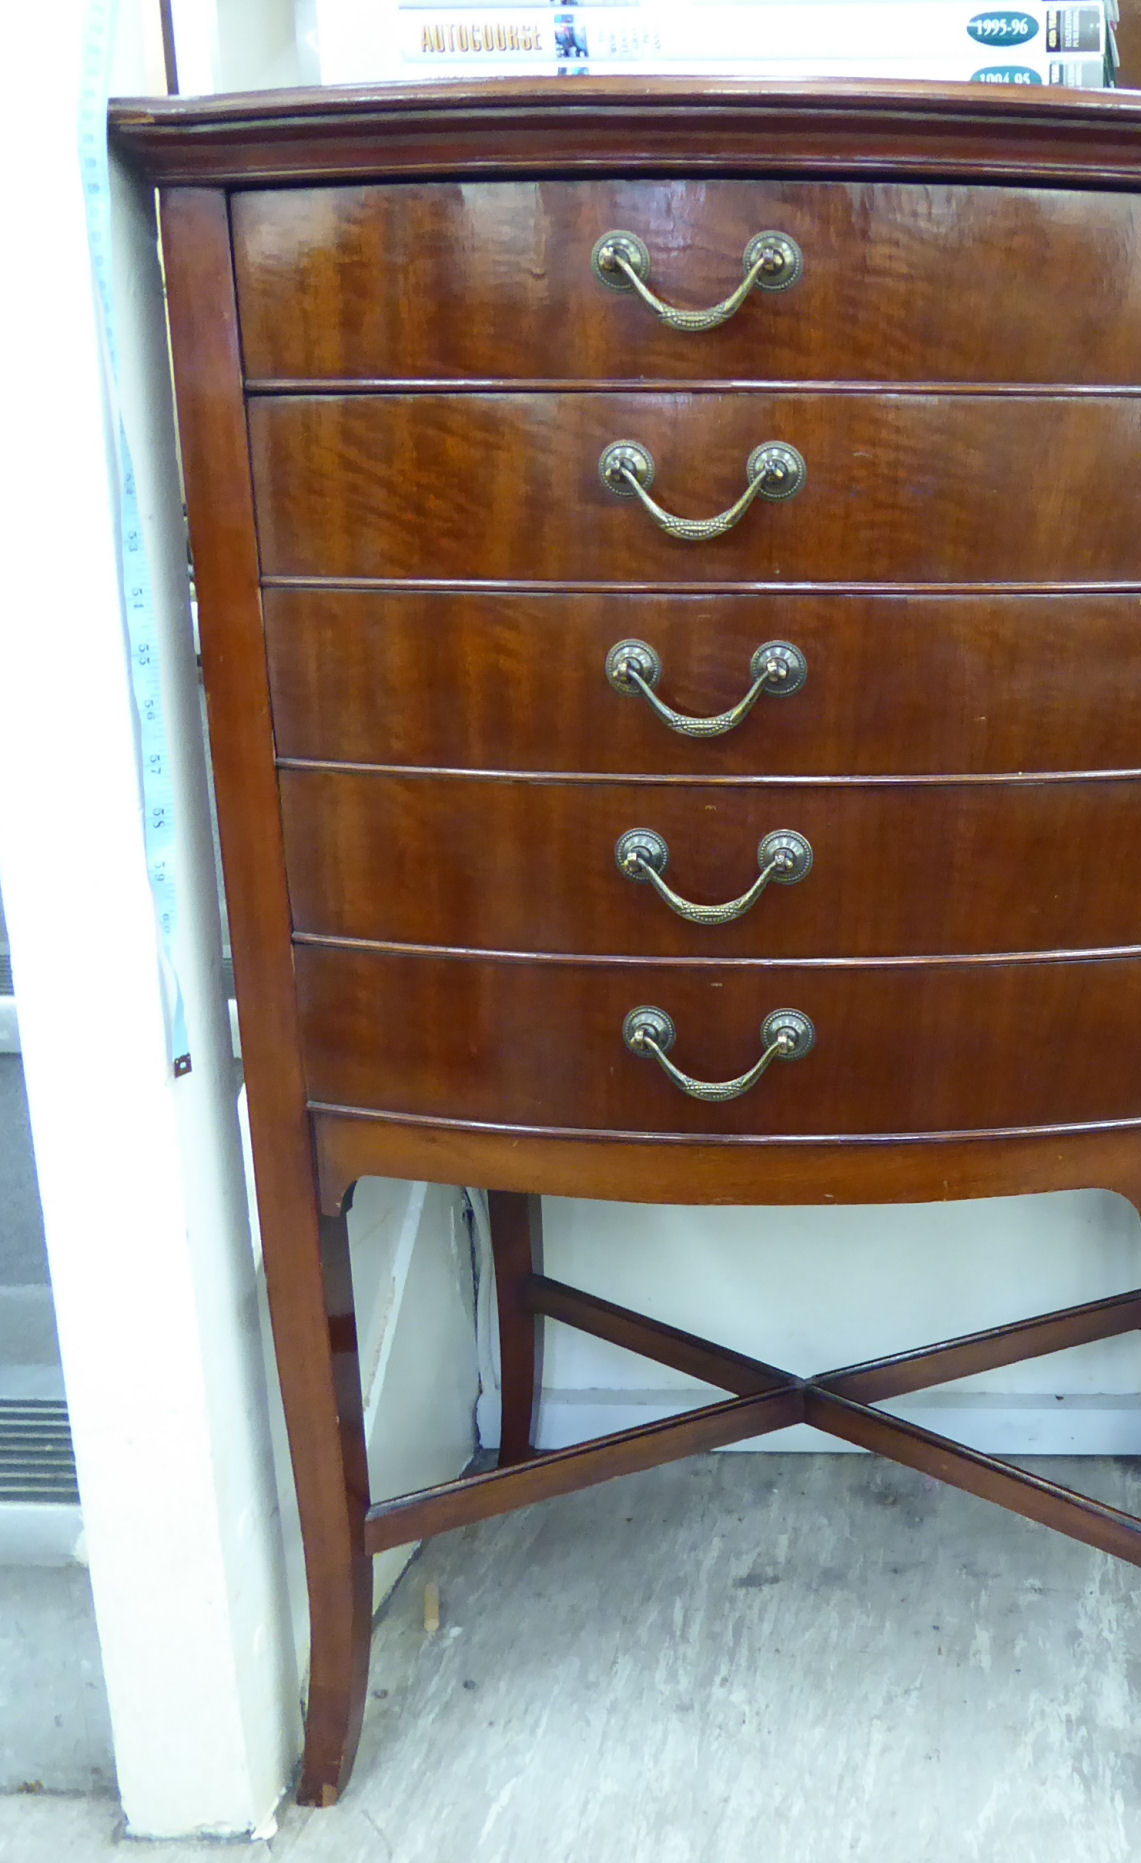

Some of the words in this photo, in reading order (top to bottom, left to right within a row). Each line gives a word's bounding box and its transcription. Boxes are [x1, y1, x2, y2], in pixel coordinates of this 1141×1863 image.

[976, 17, 1029, 36] 1995-96
[421, 23, 543, 53] AUTOCOURSE
[138, 643, 151, 666] 55
[144, 699, 156, 721] 56
[149, 754, 162, 775] 57
[152, 807, 166, 829] 58
[155, 861, 166, 882] 59
